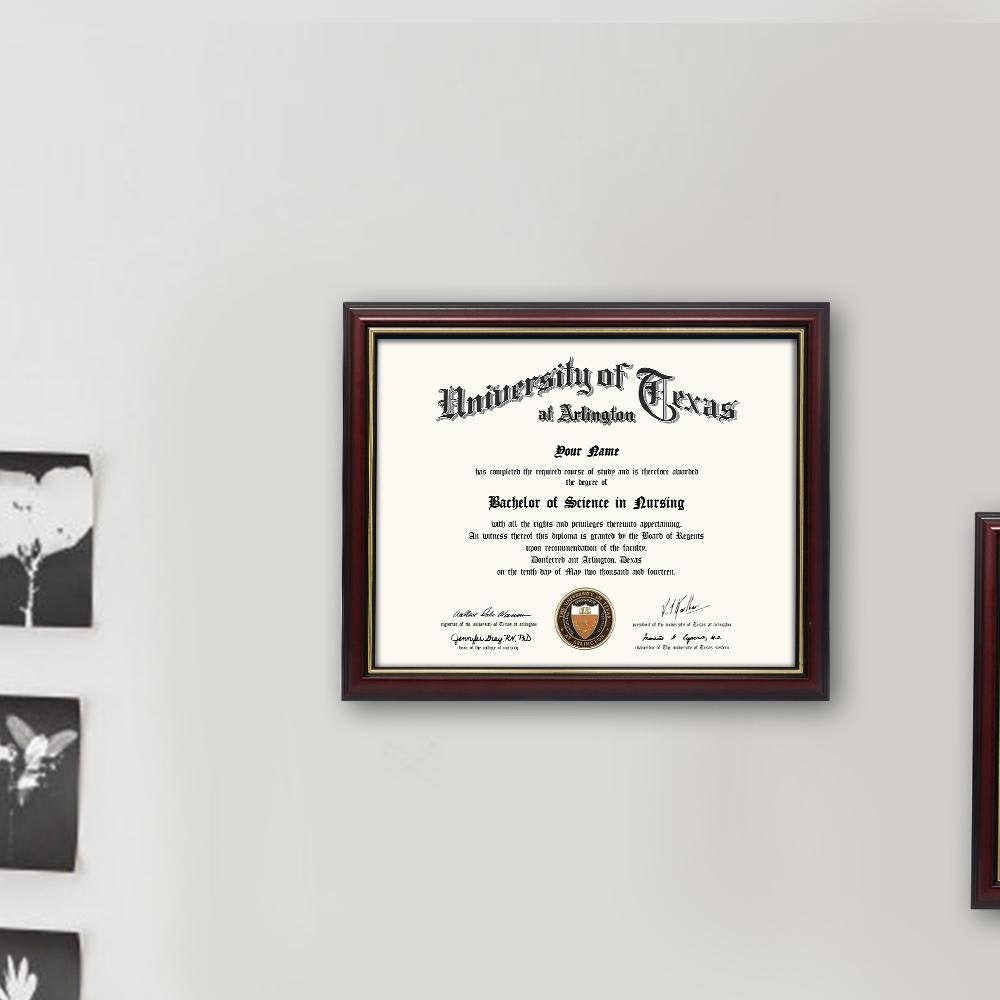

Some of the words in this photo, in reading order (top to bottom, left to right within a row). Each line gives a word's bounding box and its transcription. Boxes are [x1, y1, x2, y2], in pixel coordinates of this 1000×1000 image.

[437, 357, 594, 421] University
[597, 363, 633, 391] of
[636, 368, 739, 423] Texas
[557, 404, 636, 426] Arlington
[554, 445, 582, 458] Your
[587, 445, 619, 457] Name
[489, 496, 540, 510] Bachelor
[547, 497, 558, 508] of
[564, 496, 609, 508] Science
[616, 497, 626, 508] in
[633, 496, 684, 510] Nursing
[618, 531, 626, 540] by
